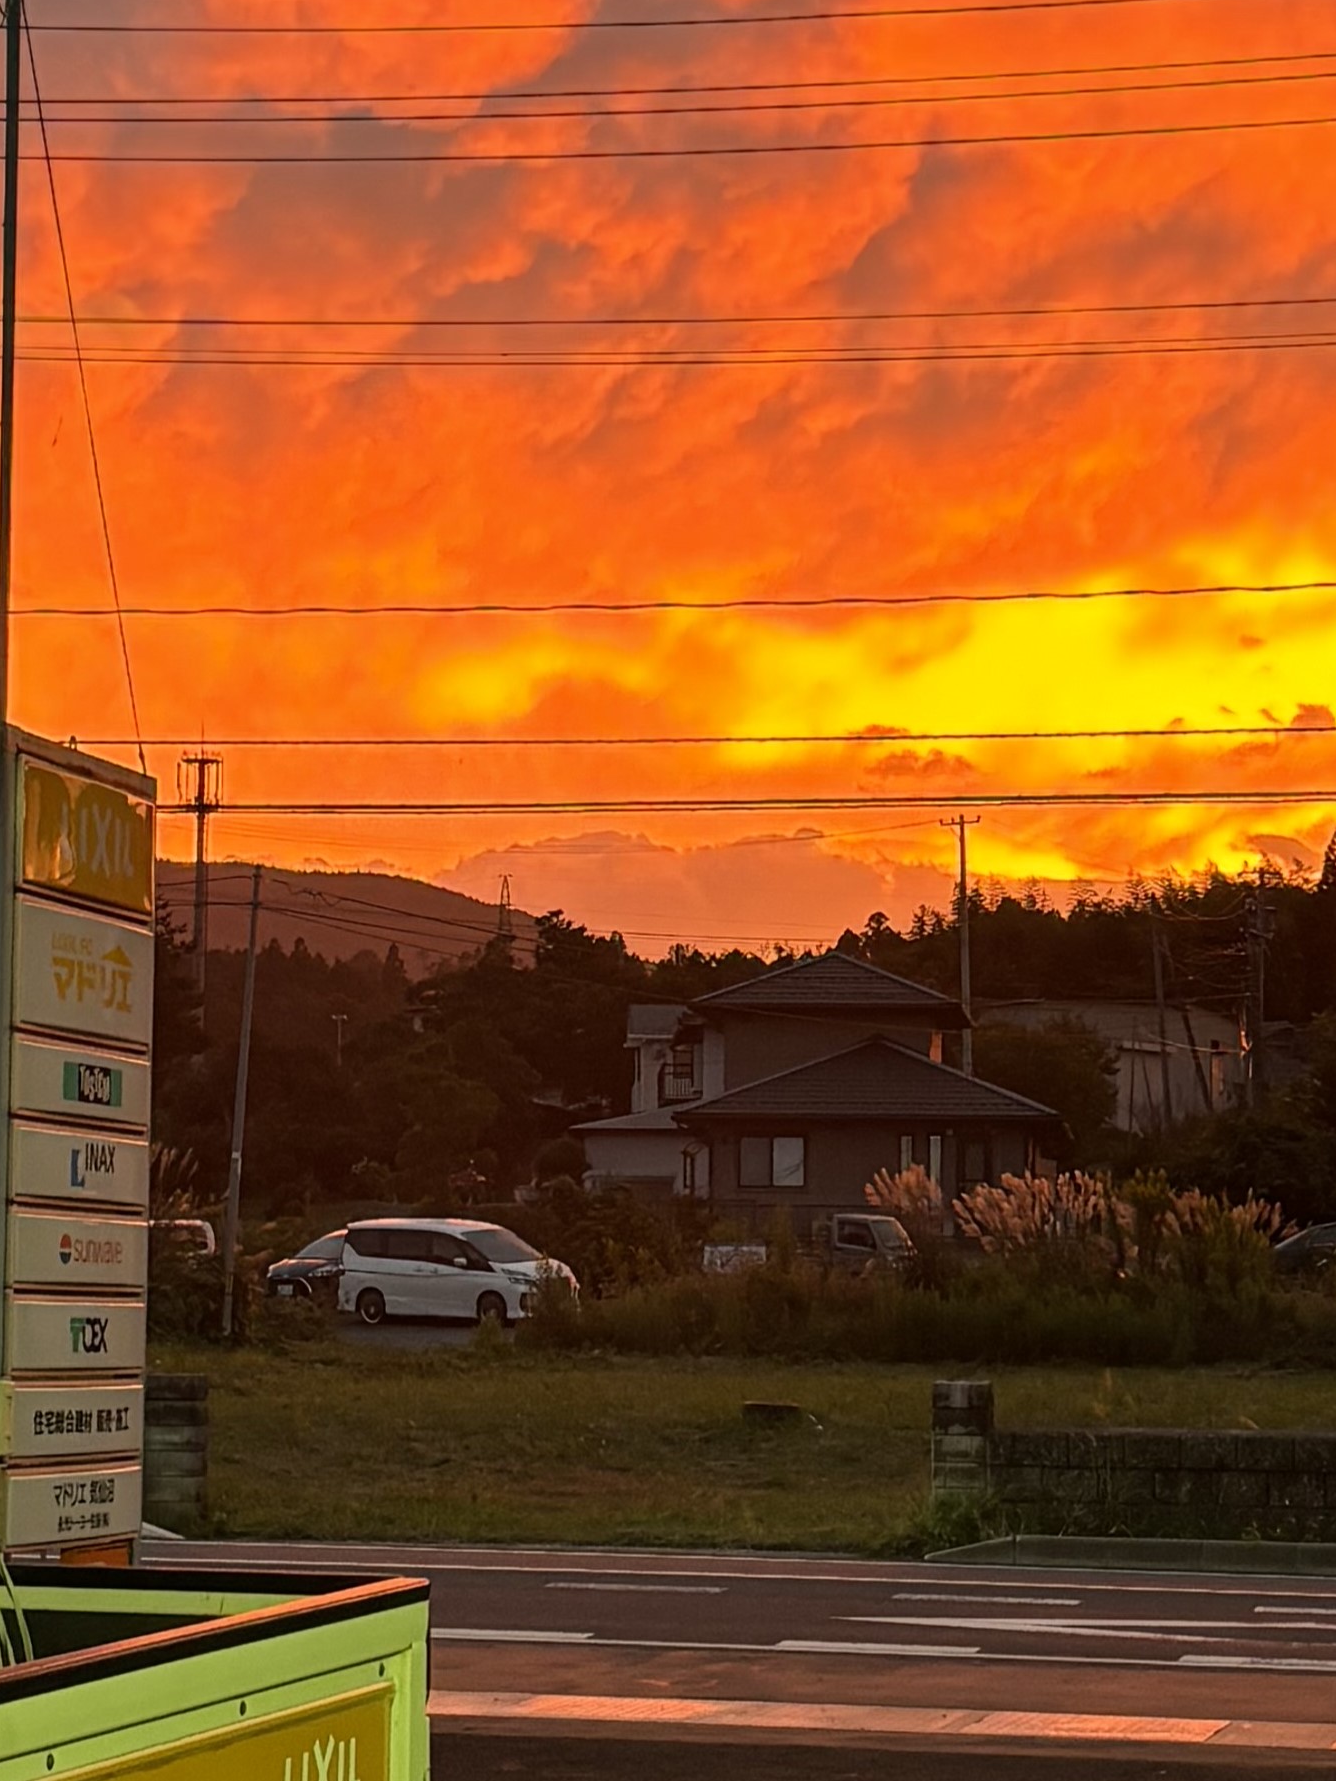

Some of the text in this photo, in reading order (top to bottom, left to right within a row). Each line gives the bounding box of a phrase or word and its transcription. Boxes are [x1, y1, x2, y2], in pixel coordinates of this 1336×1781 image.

[52, 956, 132, 1014] マドリエ
[73, 1238, 123, 1264] sunwave
[70, 1317, 108, 1354] TOEX
[53, 1483, 87, 1507] マドリエ
